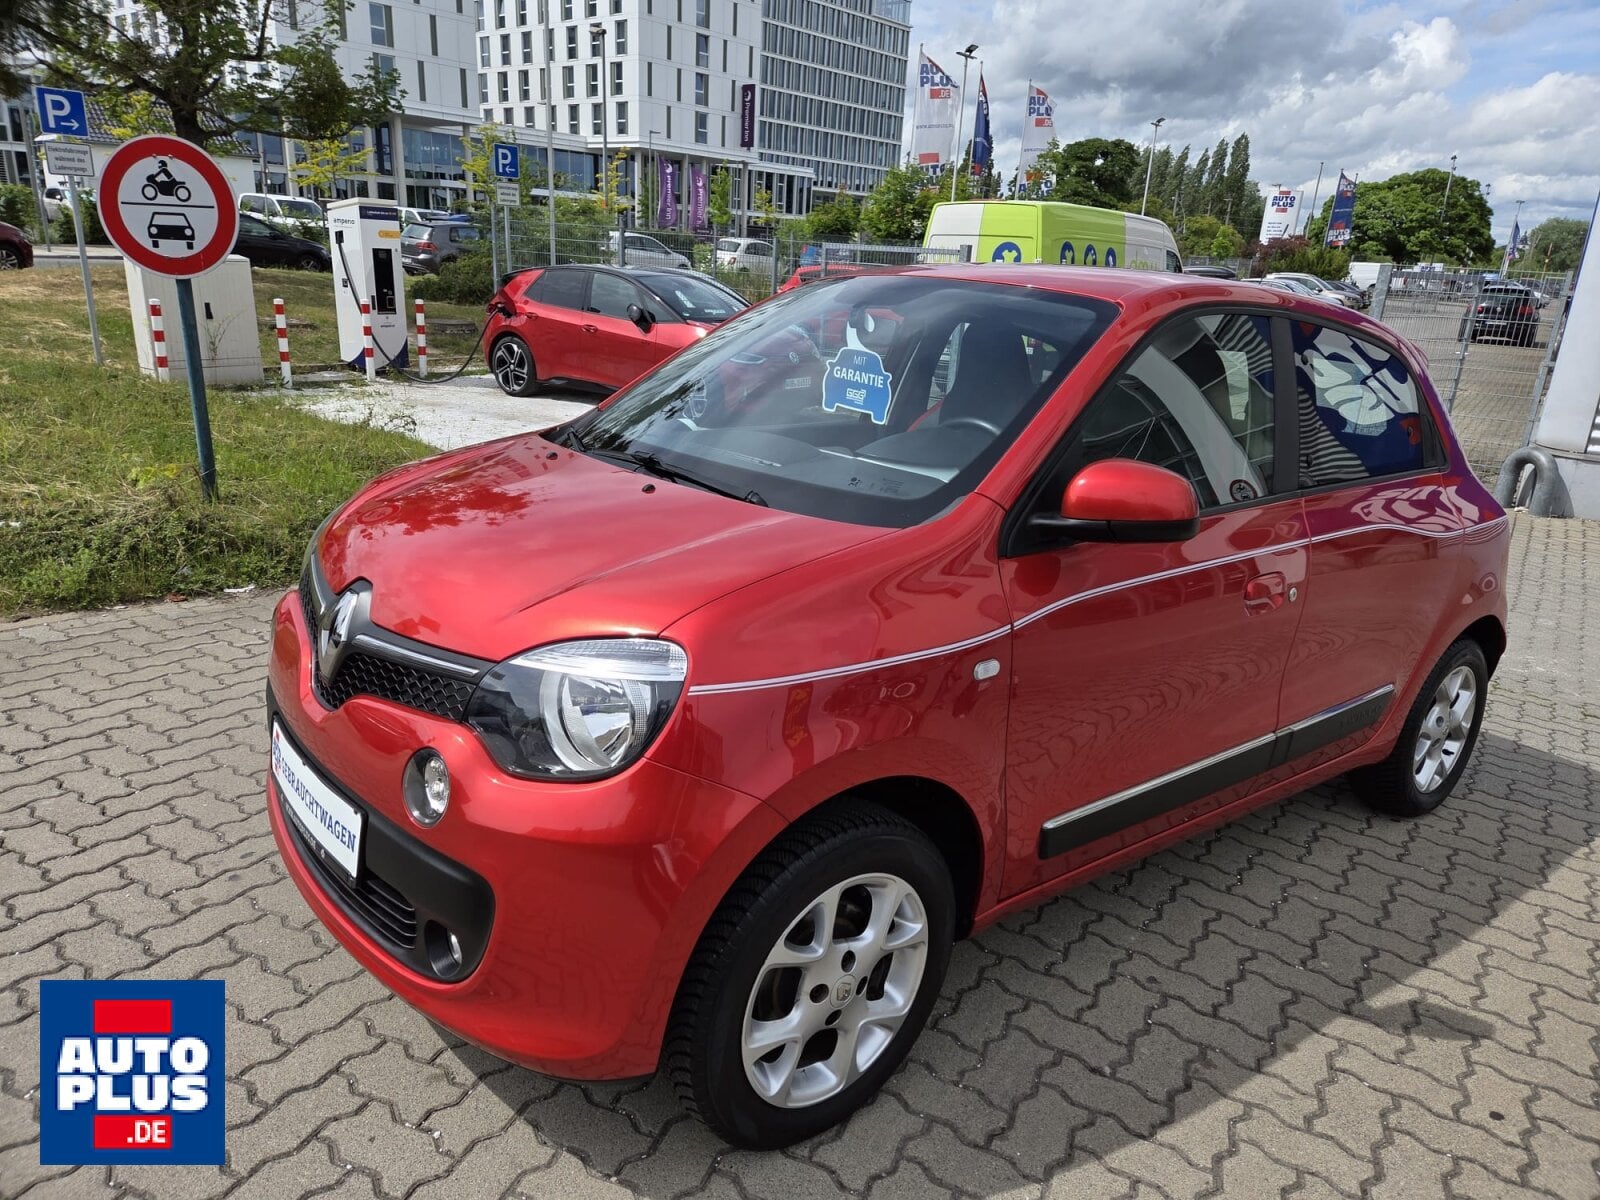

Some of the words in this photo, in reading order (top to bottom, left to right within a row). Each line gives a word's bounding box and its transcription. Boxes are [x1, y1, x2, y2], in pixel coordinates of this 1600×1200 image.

[44, 94, 71, 128] P
[498, 149, 511, 172] P
[1327, 234, 1350, 242] PLUS
[853, 355, 867, 365] MIT
[833, 366, 884, 388] GARANTIE
[281, 756, 357, 853] GEBRAUCHTWAGEN
